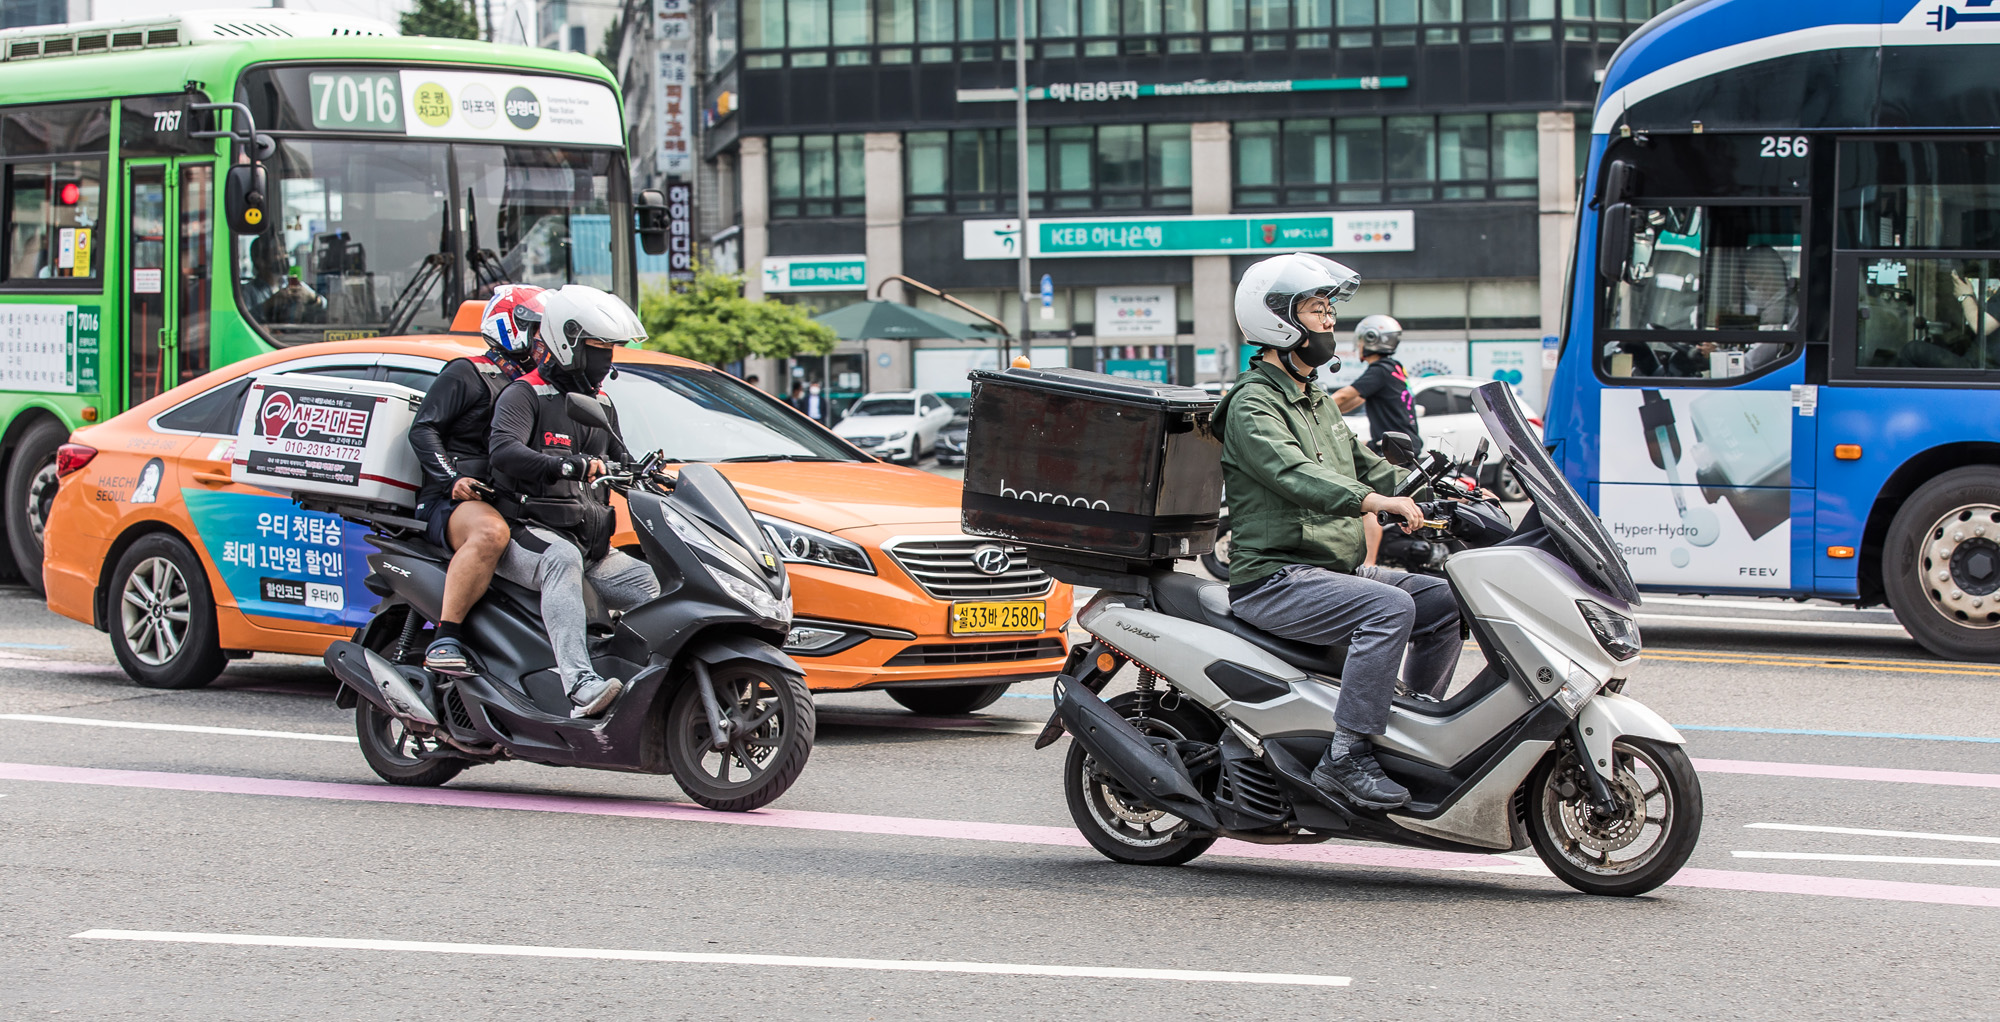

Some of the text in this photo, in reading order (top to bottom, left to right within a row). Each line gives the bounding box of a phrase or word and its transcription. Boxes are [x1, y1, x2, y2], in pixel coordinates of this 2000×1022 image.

[663, 23, 681, 37] 9F
[1050, 81, 1138, 101] 하나금융투자
[1154, 80, 1292, 96] Hana Financial Investment
[313, 75, 397, 124] 7016
[462, 100, 496, 114] 마포역
[506, 100, 540, 117] 상명대
[154, 110, 181, 131] 7767
[419, 106, 450, 118] 차고지
[665, 85, 683, 137] 피부과
[1760, 136, 1808, 157] 256
[670, 186, 690, 269] 아이미디어
[1052, 226, 1162, 248] KEB 하나은행
[1283, 229, 1300, 238] VIP
[792, 266, 862, 281] KEB 하나은행
[79, 313, 98, 331] 7016
[292, 405, 369, 437] 생각대로
[285, 441, 361, 461] 010-2313-1772
[98, 476, 137, 488] HAECHI
[96, 490, 127, 501] SEOUL
[257, 513, 341, 546] 우티 첫탑승
[1614, 523, 1698, 539] Hyper-Hydro
[1616, 542, 1657, 556] Serum
[222, 541, 343, 577] 최대 1만원 할인!
[383, 561, 411, 578] PCX
[1739, 567, 1778, 577] FEEV
[266, 583, 339, 603] 할인코드 우티10
[959, 606, 1038, 629] 서울 33바 2580
[1116, 620, 1160, 642] NMAX
